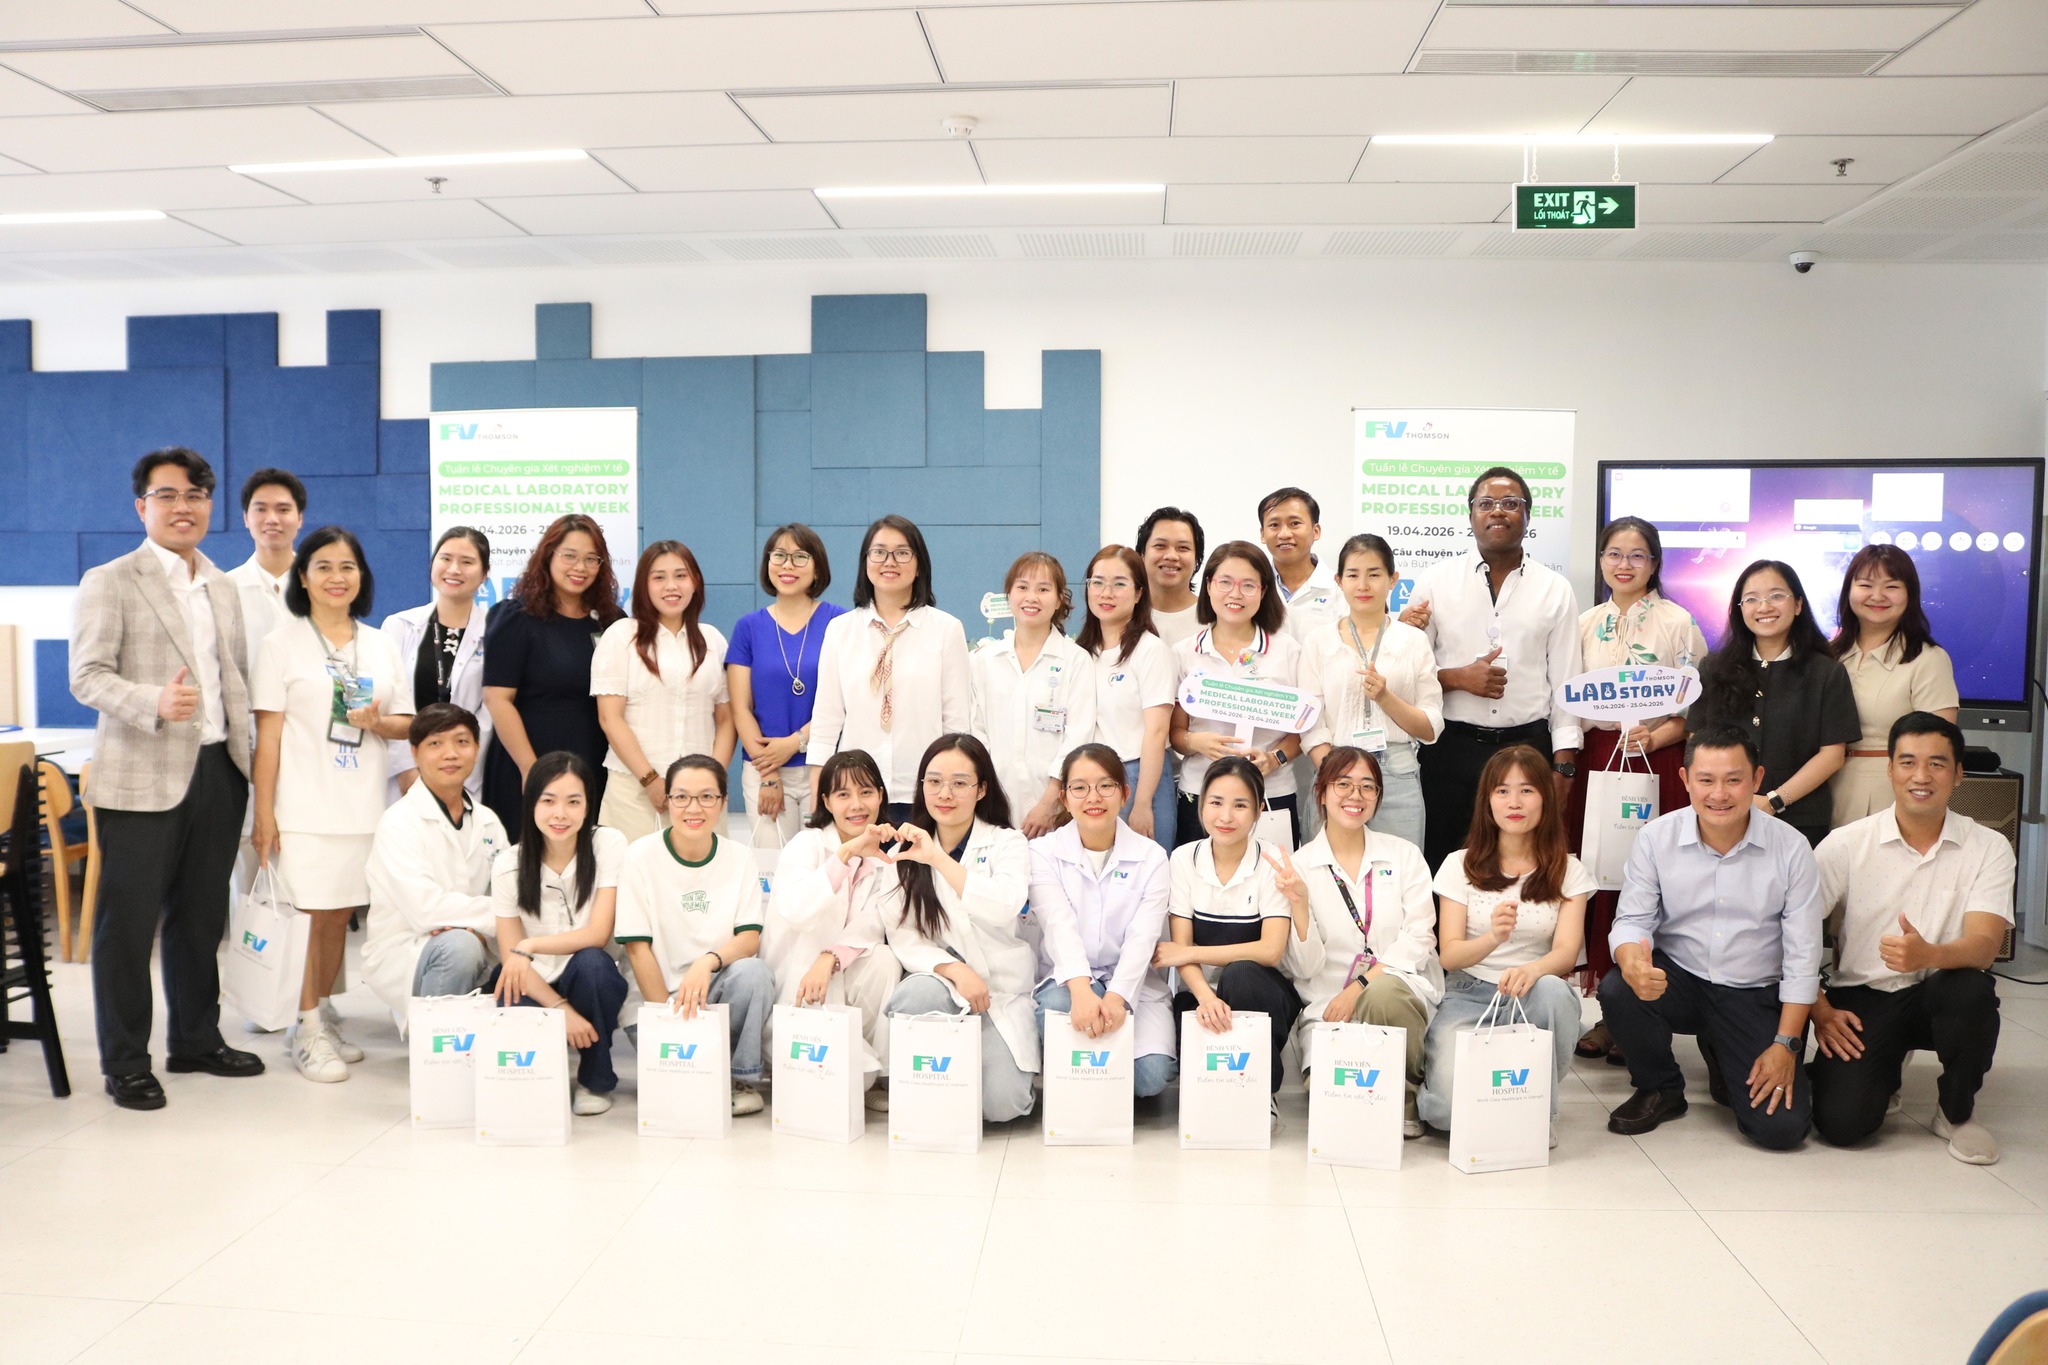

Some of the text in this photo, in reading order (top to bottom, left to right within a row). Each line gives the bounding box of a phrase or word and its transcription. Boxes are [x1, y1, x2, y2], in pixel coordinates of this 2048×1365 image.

[1534, 193, 1570, 207] EXIT
[1546, 210, 1571, 220] THOÁT
[440, 424, 479, 440] FV
[1366, 421, 1408, 438] FV
[524, 464, 540, 476] gia
[1410, 463, 1452, 476] Chuyên
[1454, 464, 1470, 475] gia
[438, 483, 629, 496] MEDICAL LABORATORY
[1362, 483, 1440, 496] MEDICAL
[439, 502, 630, 514] PROFESSIONALS WEEK
[1362, 502, 1564, 518] PROFESSION EEK
[1388, 526, 1454, 536] 19.04.2026
[1415, 548, 1453, 559] chuyện
[1618, 670, 1646, 682] FV
[1565, 682, 1676, 702] LAB STORY
[1200, 690, 1297, 711] MEDICAL LABORATORY
[1199, 698, 1296, 720] PROFESSIONALS WEEK
[1212, 708, 1242, 718] 19.04.2026
[1248, 714, 1280, 724] 25.04.2026
[334, 755, 358, 768] SEA
[1622, 802, 1652, 820] FV
[976, 856, 986, 864] FV
[1114, 871, 1128, 879] FV
[242, 930, 268, 953] FV
[432, 1034, 476, 1053] FV
[660, 1042, 698, 1060] FV
[498, 1051, 536, 1066] FV
[790, 1041, 829, 1063] FV
[1071, 1050, 1110, 1066] FV
[660, 1060, 696, 1068] HOSPITAL
[912, 1055, 952, 1072] FV
[1206, 1052, 1250, 1071] FV
[912, 1072, 951, 1080] HOSPITAL
[1071, 1067, 1110, 1075] HOSPITAL
[1334, 1068, 1380, 1088] FV
[1492, 1068, 1530, 1087] FV
[1492, 1087, 1529, 1096] HOSPITAL
